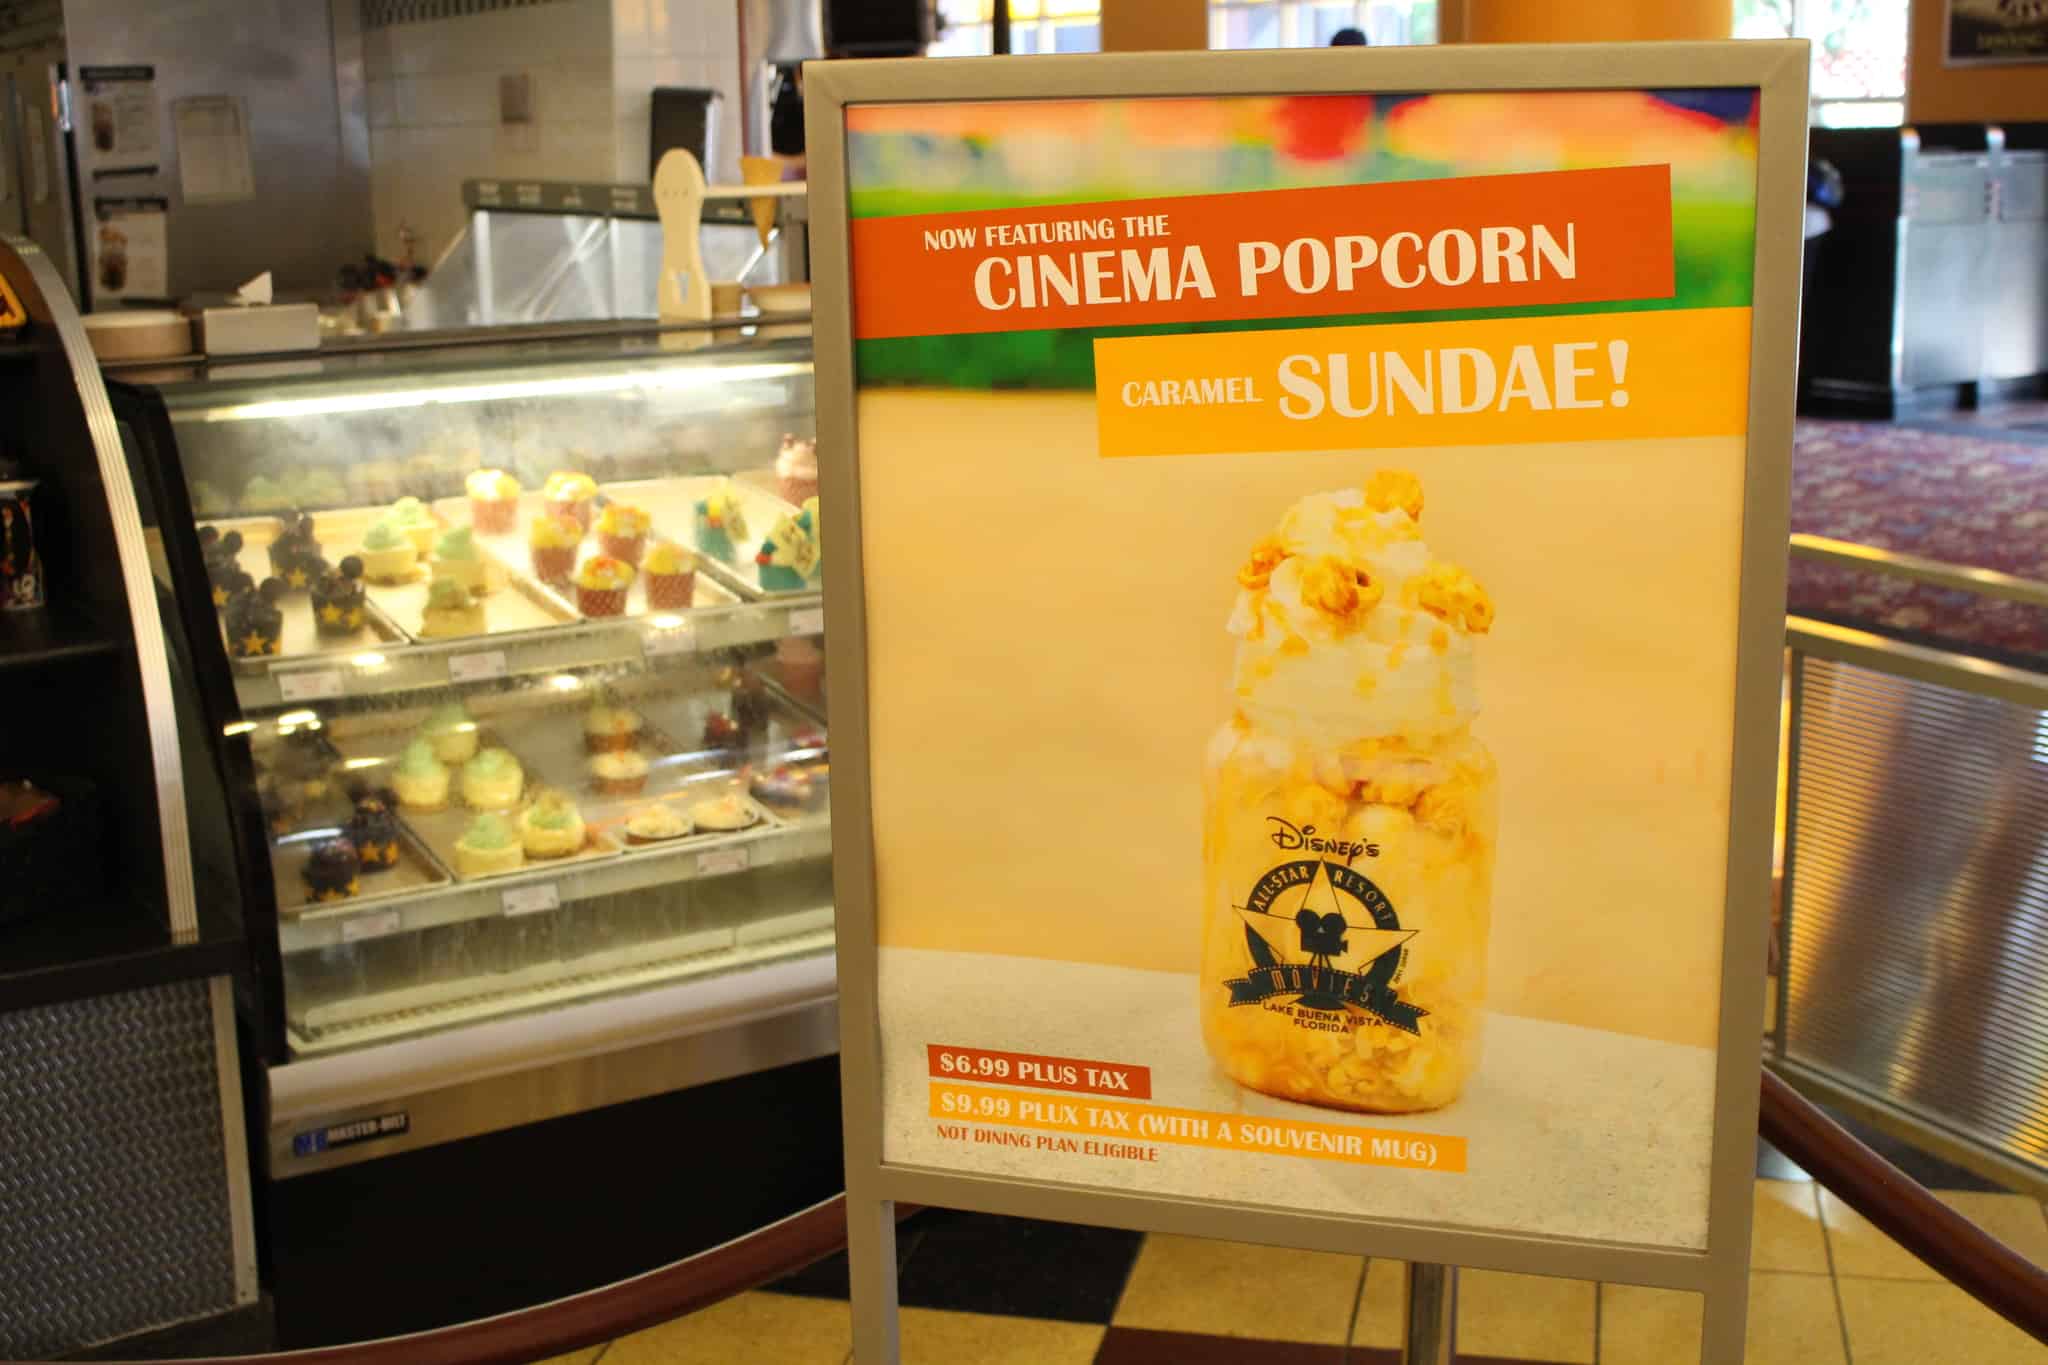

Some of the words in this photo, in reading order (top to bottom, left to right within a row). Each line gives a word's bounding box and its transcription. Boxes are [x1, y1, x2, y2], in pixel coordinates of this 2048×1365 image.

[924, 227, 977, 251] NOW
[984, 217, 1115, 248] FEATURING
[1121, 214, 1172, 239] THE
[974, 245, 1217, 311] CINEMA
[1238, 222, 1577, 297] POPCORN
[1121, 376, 1264, 408] CARAMEL
[1277, 339, 1630, 420] SUNDAE!
[1254, 864, 1310, 912] ALL-STAR
[1333, 868, 1395, 923] RESORT
[1263, 1001, 1294, 1016] LAKE
[1297, 1008, 1341, 1023] BUENA
[1346, 1015, 1384, 1028] VISTA
[1293, 1018, 1349, 1034] FLORIDA
[940, 1053, 1010, 1078] $6.99
[1018, 1061, 1078, 1086] PLUS
[1084, 1068, 1130, 1091] TAX
[937, 1124, 969, 1140] NOT
[975, 1128, 1032, 1149] DINING
[1036, 1135, 1078, 1153] PLAN
[1084, 1140, 1158, 1162] ELIGIBLE
[941, 1092, 1011, 1118] $9.99
[1019, 1101, 1079, 1126] PLUX
[1085, 1107, 1130, 1131] TAX
[1138, 1113, 1209, 1138] (WITH
[1216, 1122, 1234, 1142] A
[1240, 1122, 1362, 1156] SOUVENIR
[1371, 1137, 1438, 1164] MUG)
